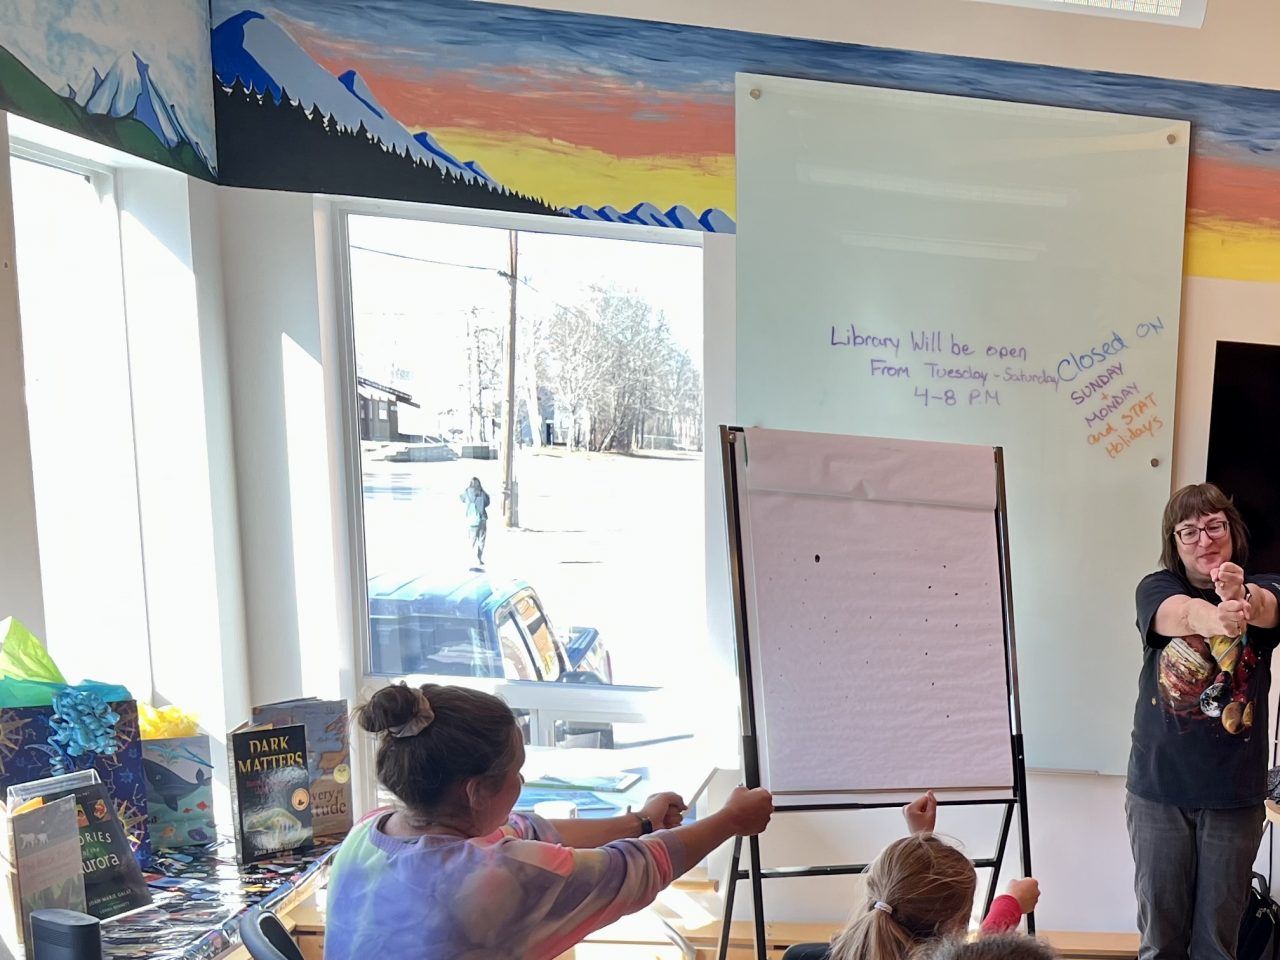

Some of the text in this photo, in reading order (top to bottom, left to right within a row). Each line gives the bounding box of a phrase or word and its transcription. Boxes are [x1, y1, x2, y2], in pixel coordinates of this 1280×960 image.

[831, 324, 1028, 362] Library Will be open
[1057, 316, 1165, 382] Closed ON
[870, 359, 911, 378] From
[923, 362, 988, 386] Tuesday
[1070, 361, 1125, 405] SUNDAY
[1084, 382, 1140, 428] MONDAY
[1087, 391, 1158, 446] and STAT
[237, 751, 304, 775] MATTERS
[248, 735, 290, 754] DARK
[81, 853, 120, 874] urora
